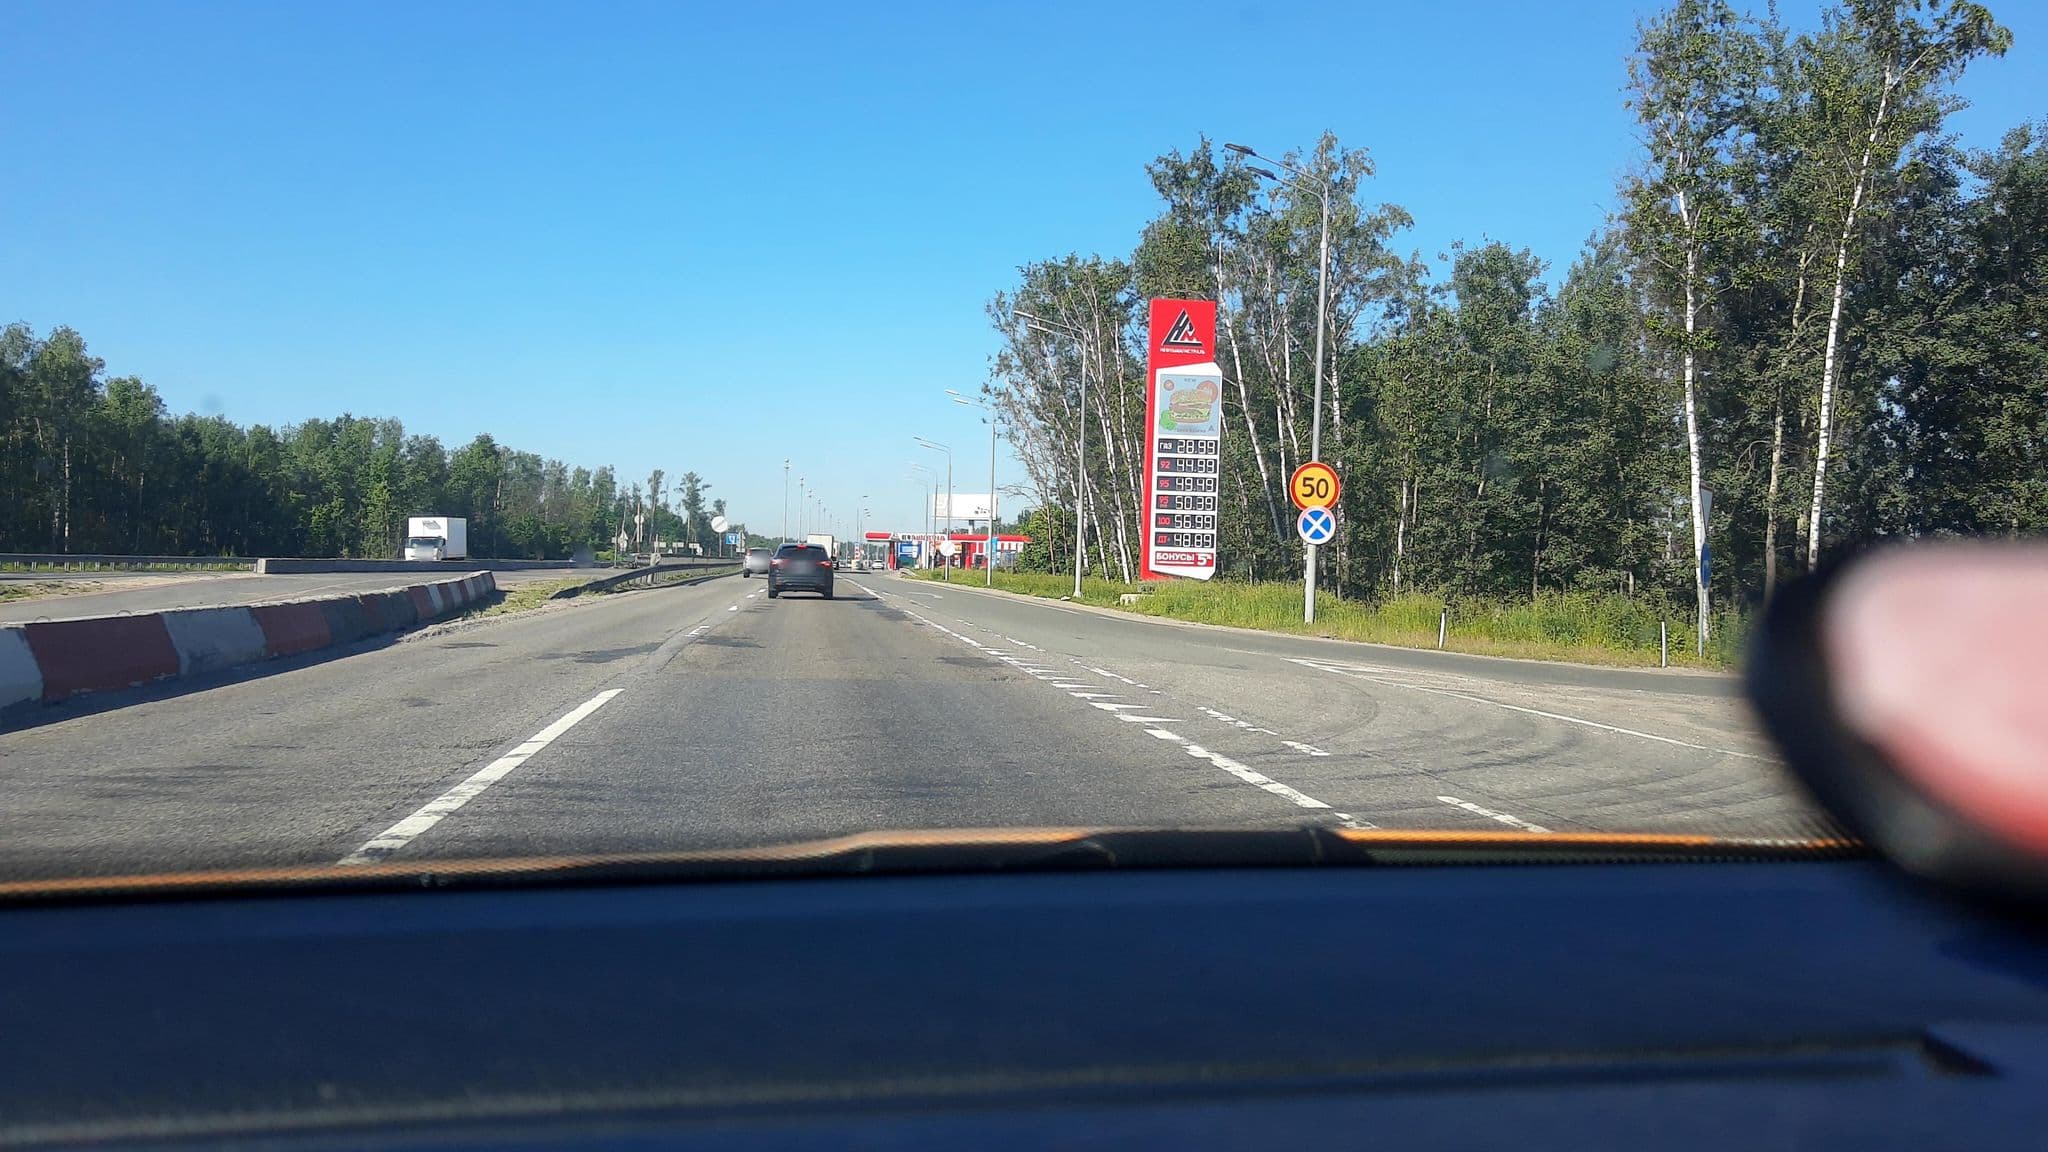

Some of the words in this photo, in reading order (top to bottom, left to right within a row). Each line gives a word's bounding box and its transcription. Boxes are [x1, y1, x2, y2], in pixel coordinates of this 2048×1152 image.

[1177, 440, 1215, 455] 28.99
[1160, 461, 1170, 469] 92
[1177, 459, 1214, 473] 44.99
[1176, 478, 1213, 492] 49.49
[1302, 477, 1329, 499] 50
[1176, 496, 1213, 510] 50.39
[1159, 517, 1170, 525] 100
[1175, 515, 1212, 529] 56.99
[1174, 533, 1211, 547] 48.89
[1156, 552, 1195, 561] БОНУСЫ
